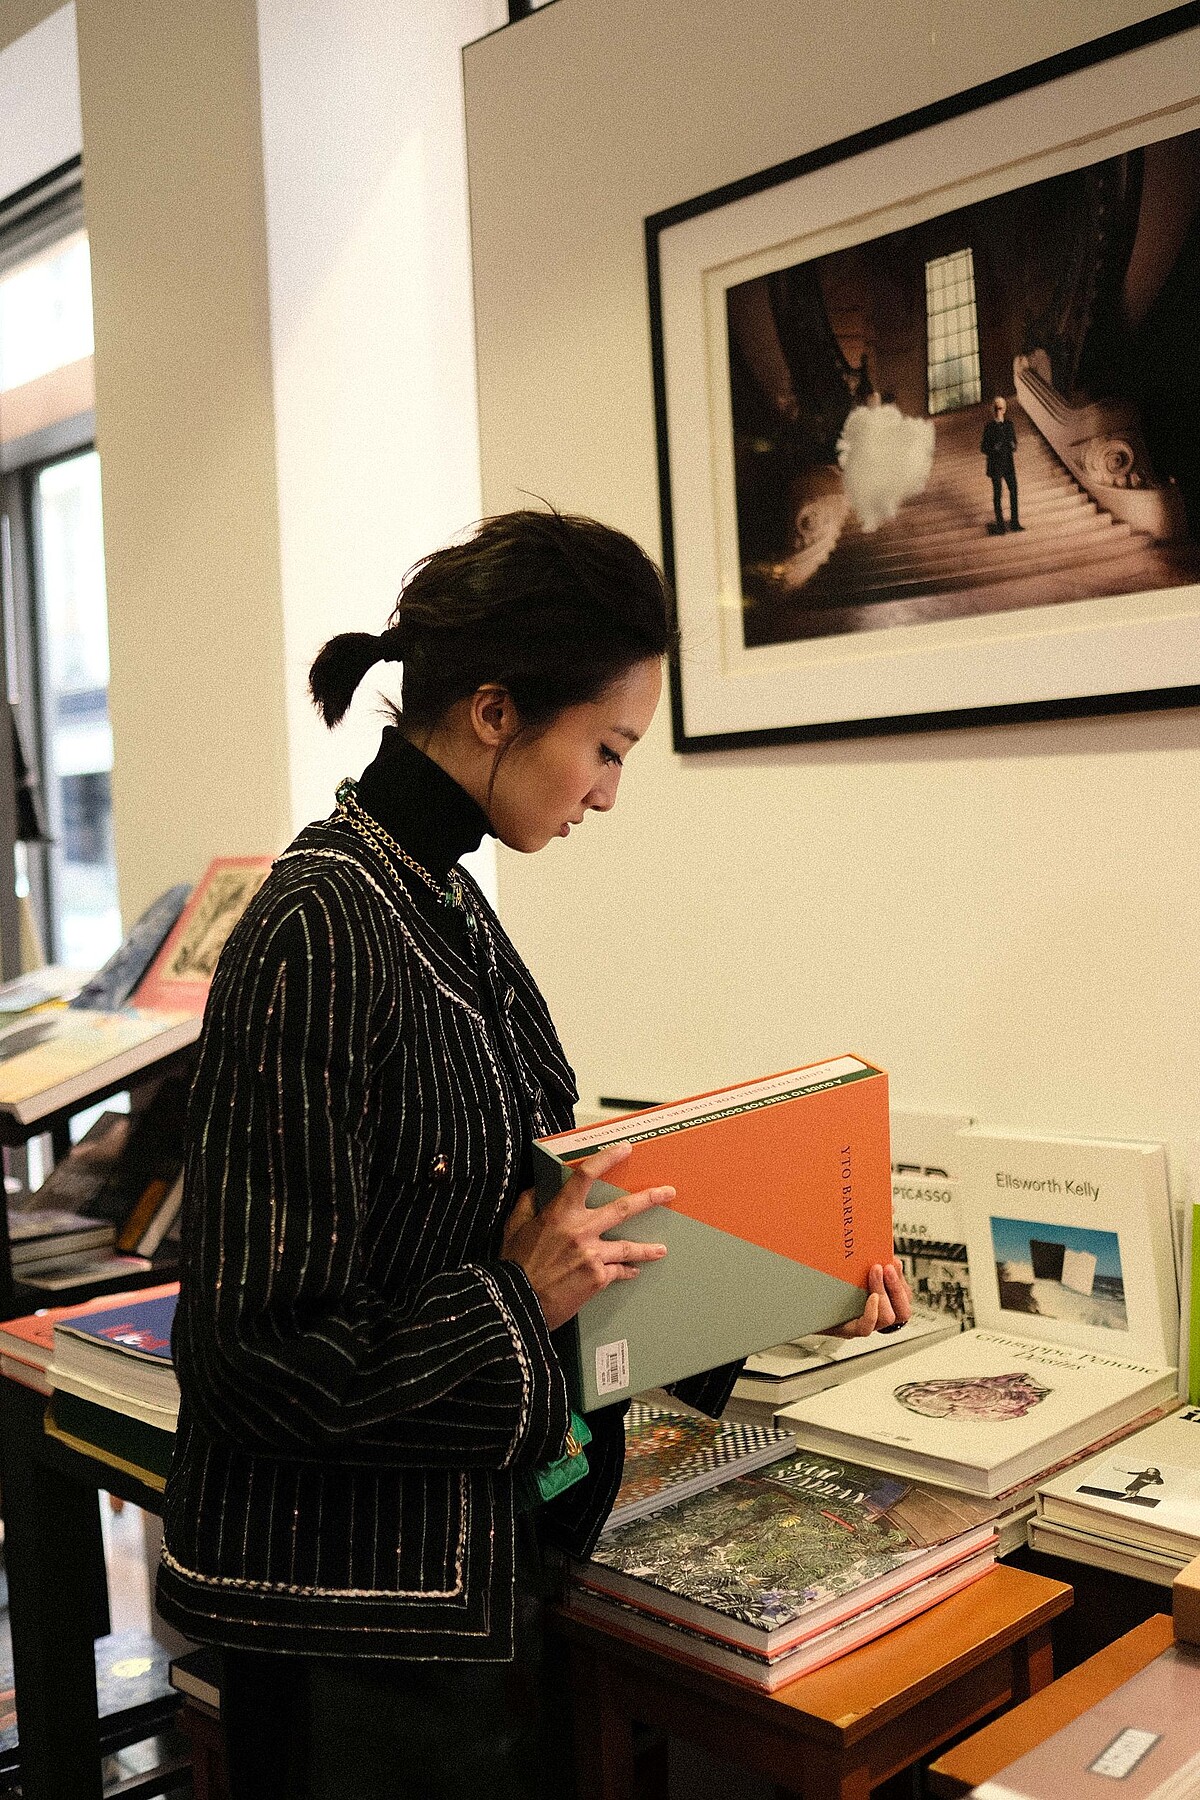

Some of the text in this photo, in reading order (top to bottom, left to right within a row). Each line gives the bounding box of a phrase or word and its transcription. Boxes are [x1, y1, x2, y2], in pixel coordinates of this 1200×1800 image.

[804, 1082, 835, 1093] GUIDE
[742, 1101, 765, 1110] FOR
[763, 1094, 792, 1104] TREES
[643, 1115, 665, 1124] AND
[682, 1107, 743, 1128] GOVERNORS
[574, 1122, 641, 1143] FOREIGNERS
[658, 1124, 681, 1134] AND
[996, 1173, 1099, 1202] Ellsworth Kelly
[893, 1186, 951, 1204] PICASSO
[841, 1146, 854, 1259] YTO BARRADA
